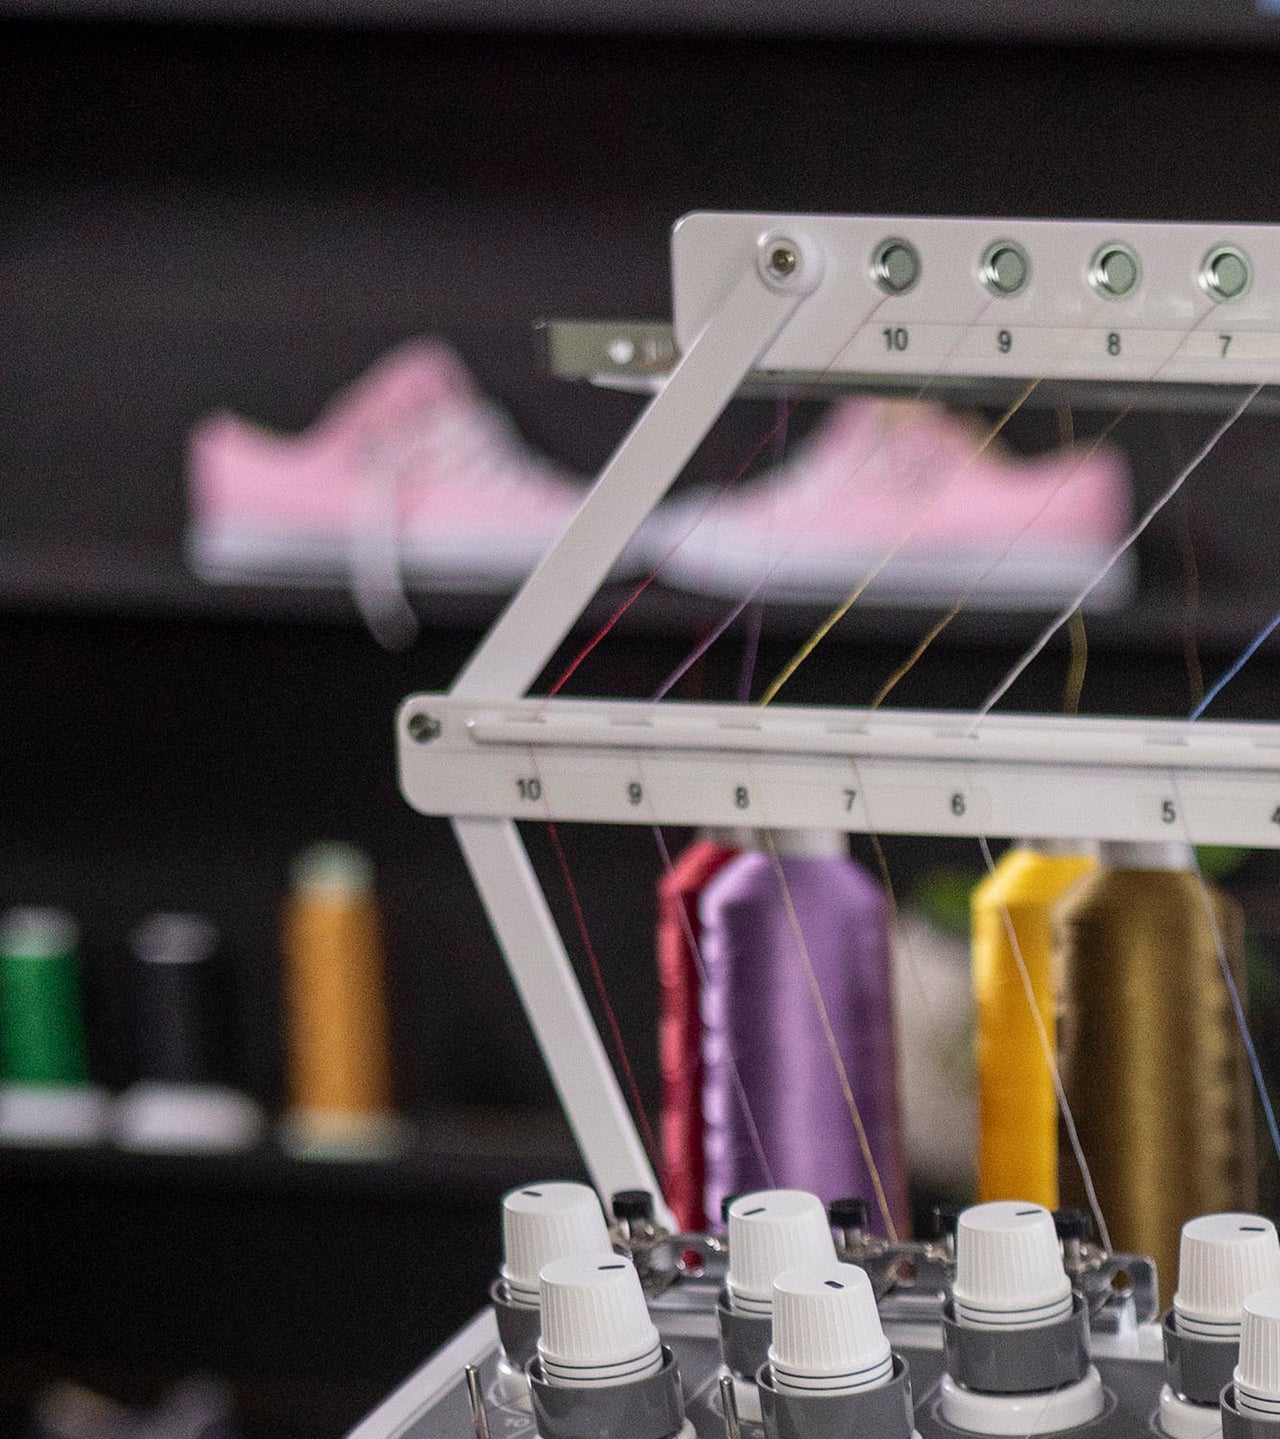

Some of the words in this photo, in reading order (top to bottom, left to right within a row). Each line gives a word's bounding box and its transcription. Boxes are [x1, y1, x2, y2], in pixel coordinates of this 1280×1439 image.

[883, 328, 908, 352] 10
[998, 330, 1012, 353] 9
[1108, 333, 1121, 356] 8
[1219, 336, 1232, 358] 7
[516, 778, 541, 801] 10
[628, 782, 642, 805] 9
[735, 786, 749, 809] 8
[843, 790, 858, 812] 7
[951, 793, 966, 816] 6
[1161, 801, 1176, 824] 5
